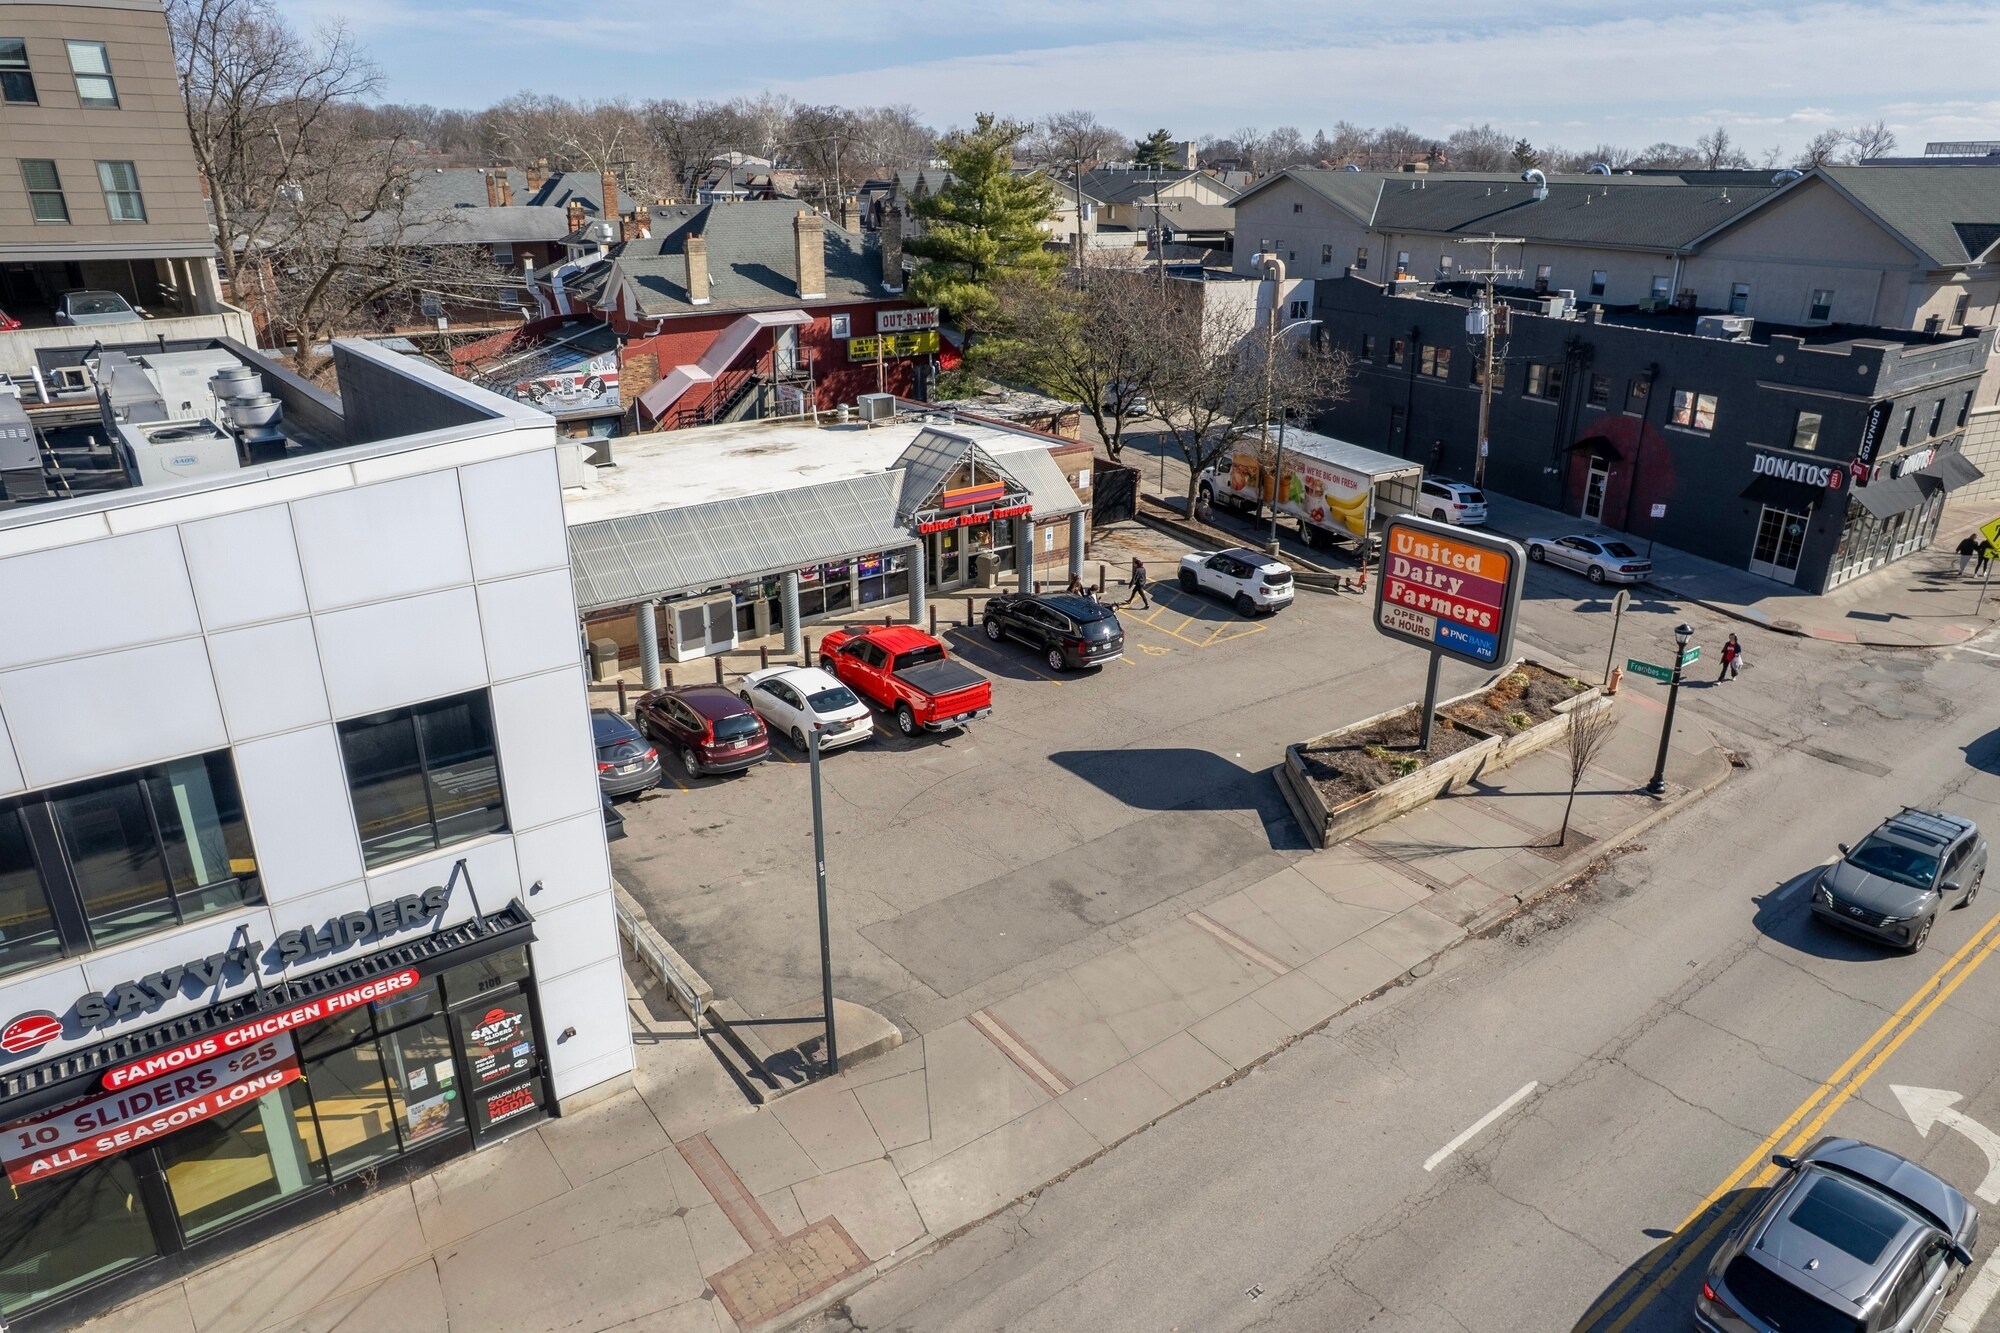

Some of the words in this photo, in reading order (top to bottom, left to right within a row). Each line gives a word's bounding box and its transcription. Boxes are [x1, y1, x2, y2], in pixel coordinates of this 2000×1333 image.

[590, 357, 615, 372] Ohio
[1862, 409, 1881, 461] DONATOS
[1306, 466, 1322, 478] WE'RE
[1323, 471, 1332, 481] BIG
[1332, 475, 1341, 484] ON
[1340, 478, 1358, 490] FRESH
[1753, 453, 1831, 488] DONATOS
[920, 516, 956, 533] United
[960, 513, 989, 526] Dairy
[993, 504, 1033, 519] Farmers
[1396, 533, 1481, 573] United
[1393, 557, 1464, 595] Dairy
[1389, 581, 1491, 627] Farmers
[1393, 608, 1423, 623] OPEN
[1384, 615, 1395, 626] 24
[1399, 619, 1430, 637] HOURS
[1450, 629, 1469, 642] PNC
[1469, 635, 1492, 649] BANK
[1476, 647, 1491, 657] ATM
[76, 940, 264, 1028] SAVVY
[278, 885, 449, 963] SLIDERS
[112, 1039, 218, 1086] FAMOUS
[225, 1003, 320, 1046] CHICKEN
[327, 972, 413, 1012] FINGERS
[471, 1014, 522, 1040] SAVVY
[484, 1027, 513, 1041] SLIDERS
[482, 1068, 511, 1081] FACILITY
[18, 1126, 60, 1150] 10
[74, 1068, 217, 1133] SLIDERS
[228, 1042, 277, 1072] $25
[488, 1090, 512, 1102] FOLLOW
[513, 1085, 521, 1093] US
[488, 1088, 532, 1110] SOCIAL
[489, 1096, 534, 1118] MEDIA
[30, 1148, 88, 1175] ALL
[95, 1100, 208, 1152] SEASON
[215, 1069, 283, 1109] LONG
